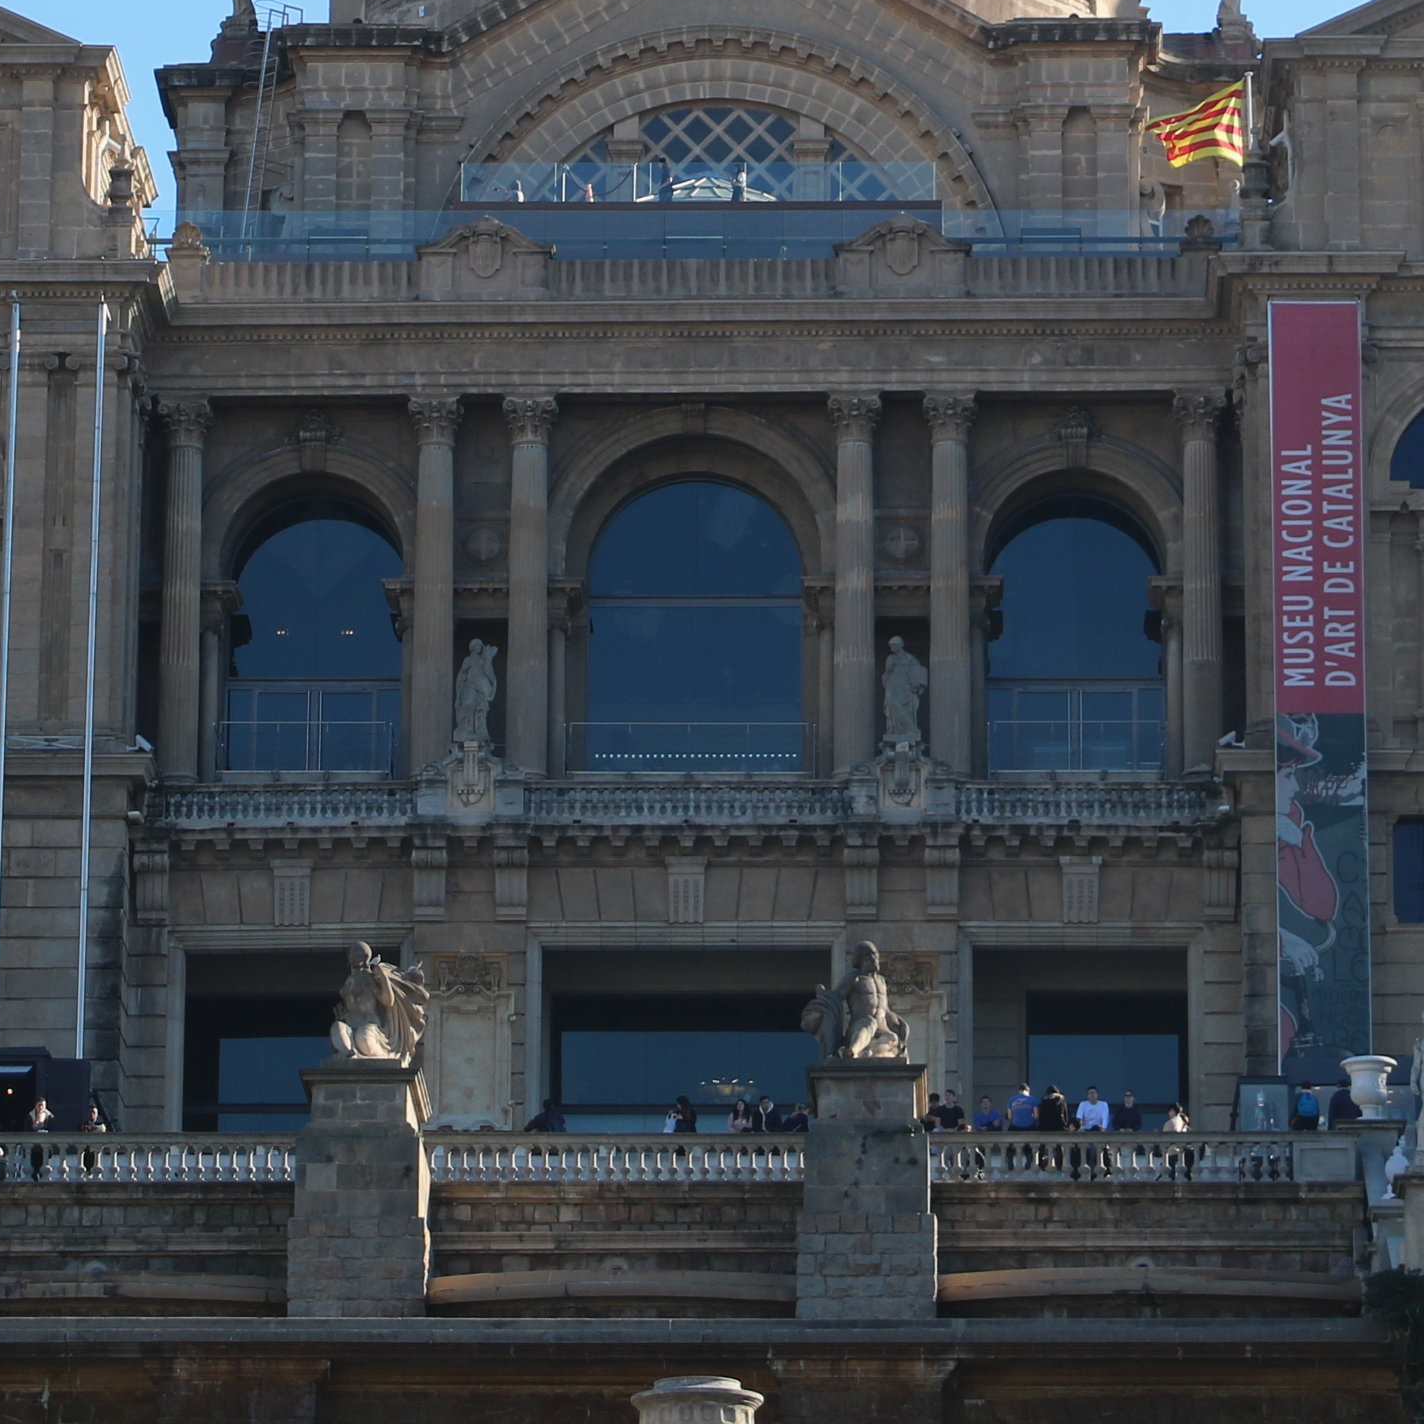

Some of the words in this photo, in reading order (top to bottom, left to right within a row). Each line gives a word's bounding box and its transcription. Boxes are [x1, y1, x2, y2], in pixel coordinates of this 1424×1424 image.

[1281, 444, 1313, 581] NACIONAL
[1321, 393, 1354, 548] CATALUNYA
[1323, 561, 1355, 593] DE
[1282, 595, 1315, 687] MUSEU
[1323, 607, 1356, 687] D'ART
